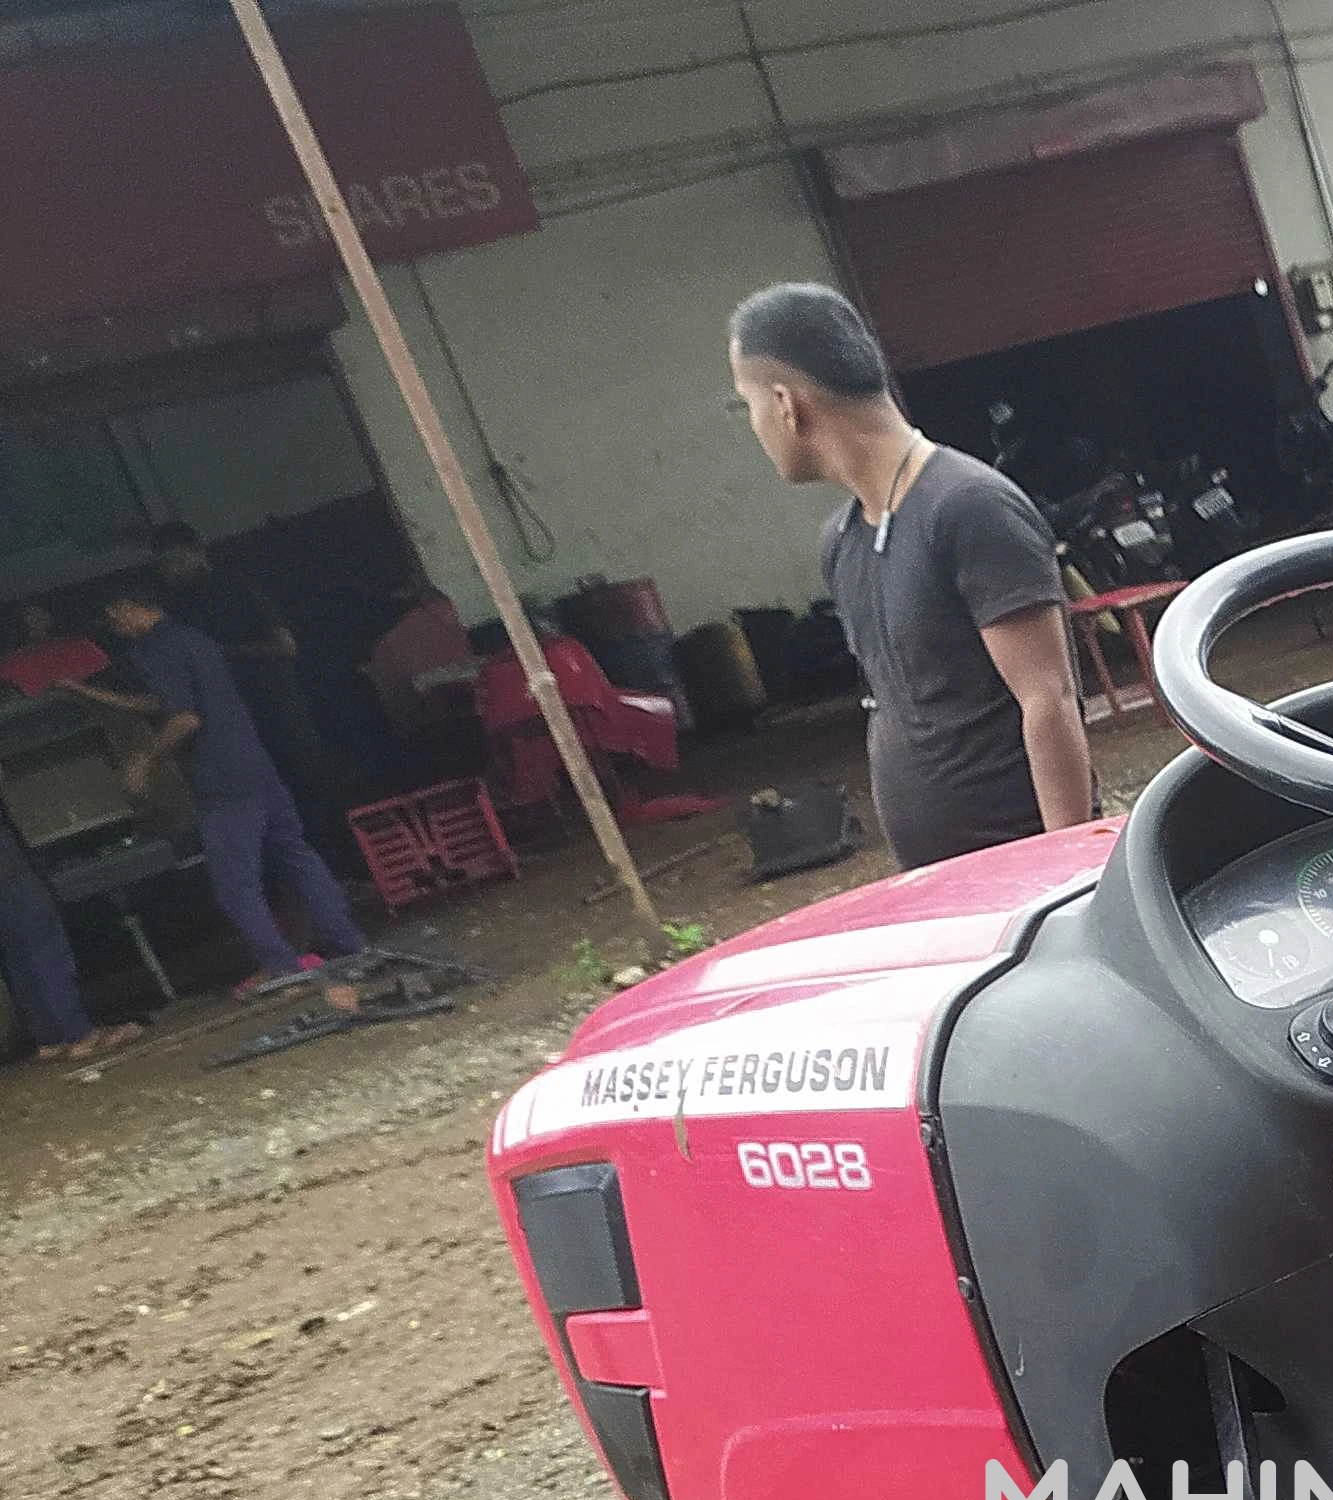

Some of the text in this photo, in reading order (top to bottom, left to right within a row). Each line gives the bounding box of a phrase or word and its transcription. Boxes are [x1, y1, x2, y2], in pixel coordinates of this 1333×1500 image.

[581, 1045, 890, 1108] MASSEY FERGUSON
[737, 1141, 873, 1191] 6028
